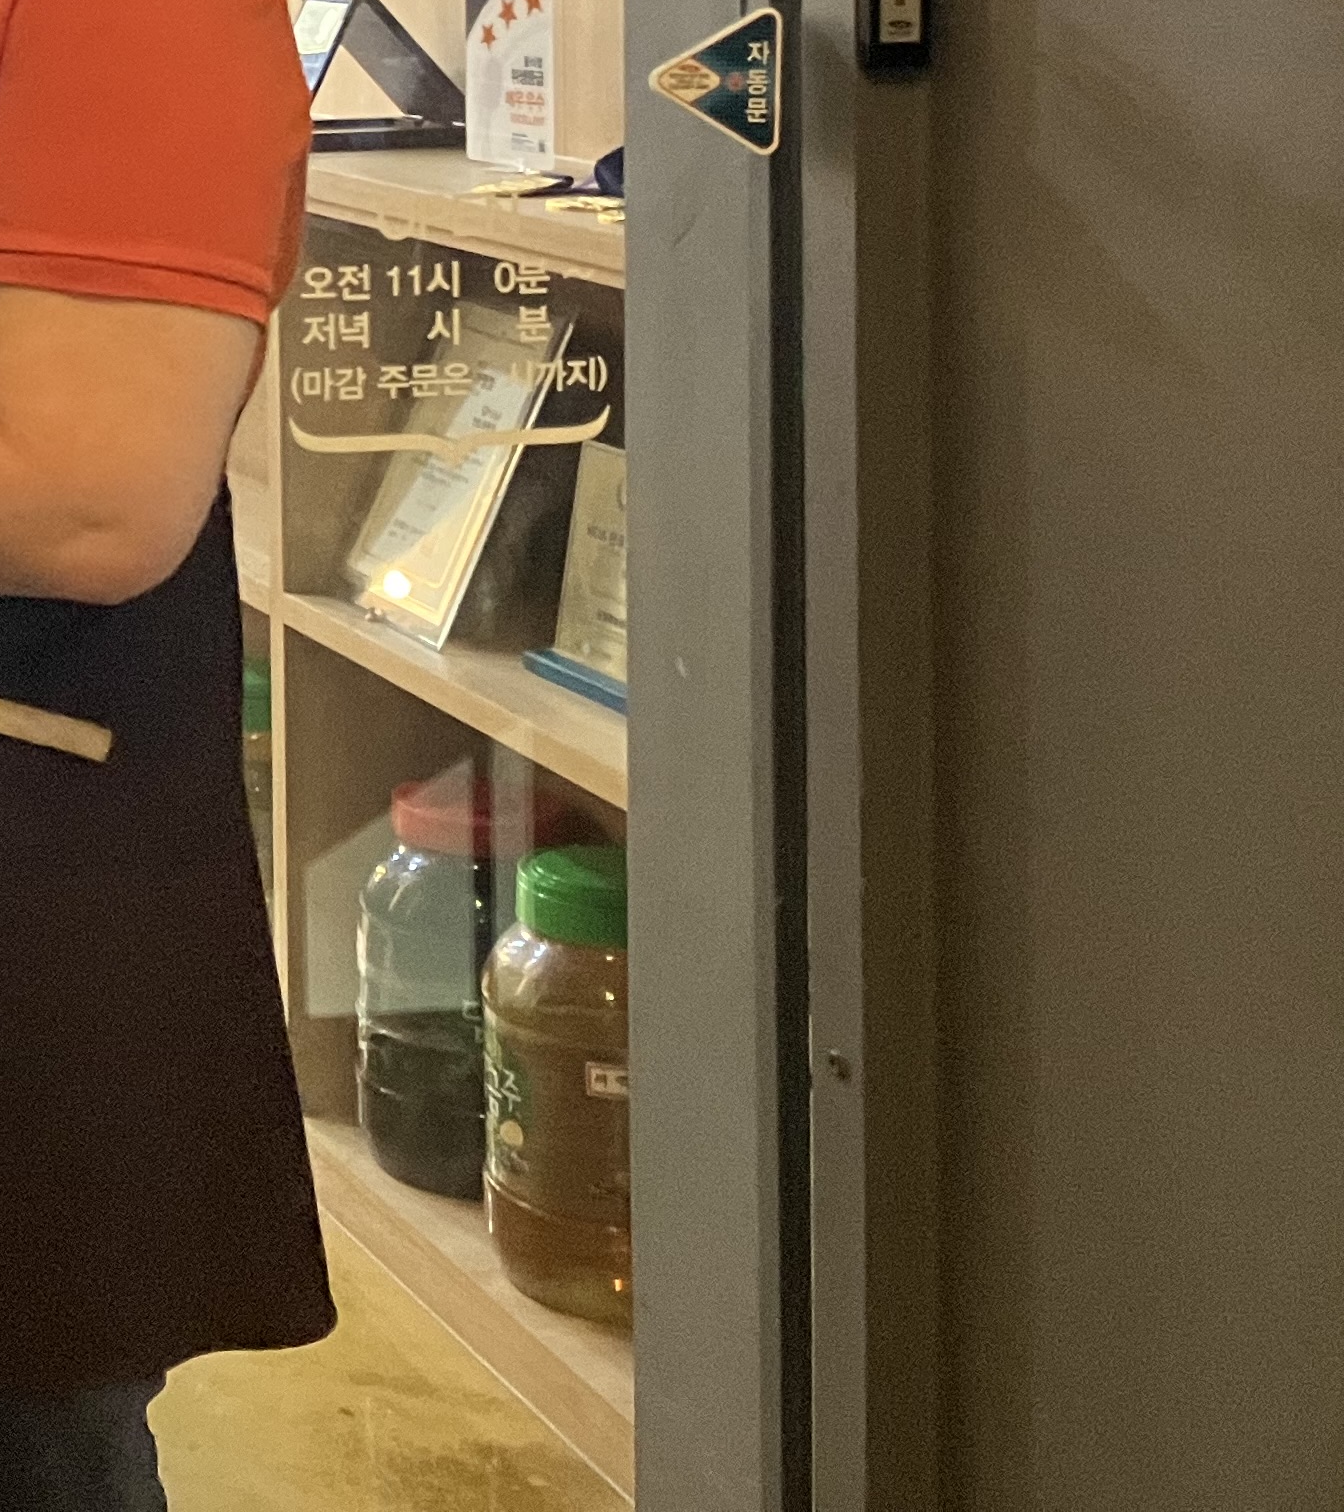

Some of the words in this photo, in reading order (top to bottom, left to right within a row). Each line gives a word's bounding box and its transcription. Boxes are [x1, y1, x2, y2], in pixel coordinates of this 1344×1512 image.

[745, 40, 770, 123] 자동문
[300, 264, 371, 300] 오전
[387, 261, 461, 298] 11시
[494, 261, 551, 295] 0분
[301, 311, 370, 349] 저녁
[427, 309, 460, 345] 시
[516, 305, 552, 342] 분
[290, 364, 367, 403] (마감
[377, 363, 472, 399] 주문은
